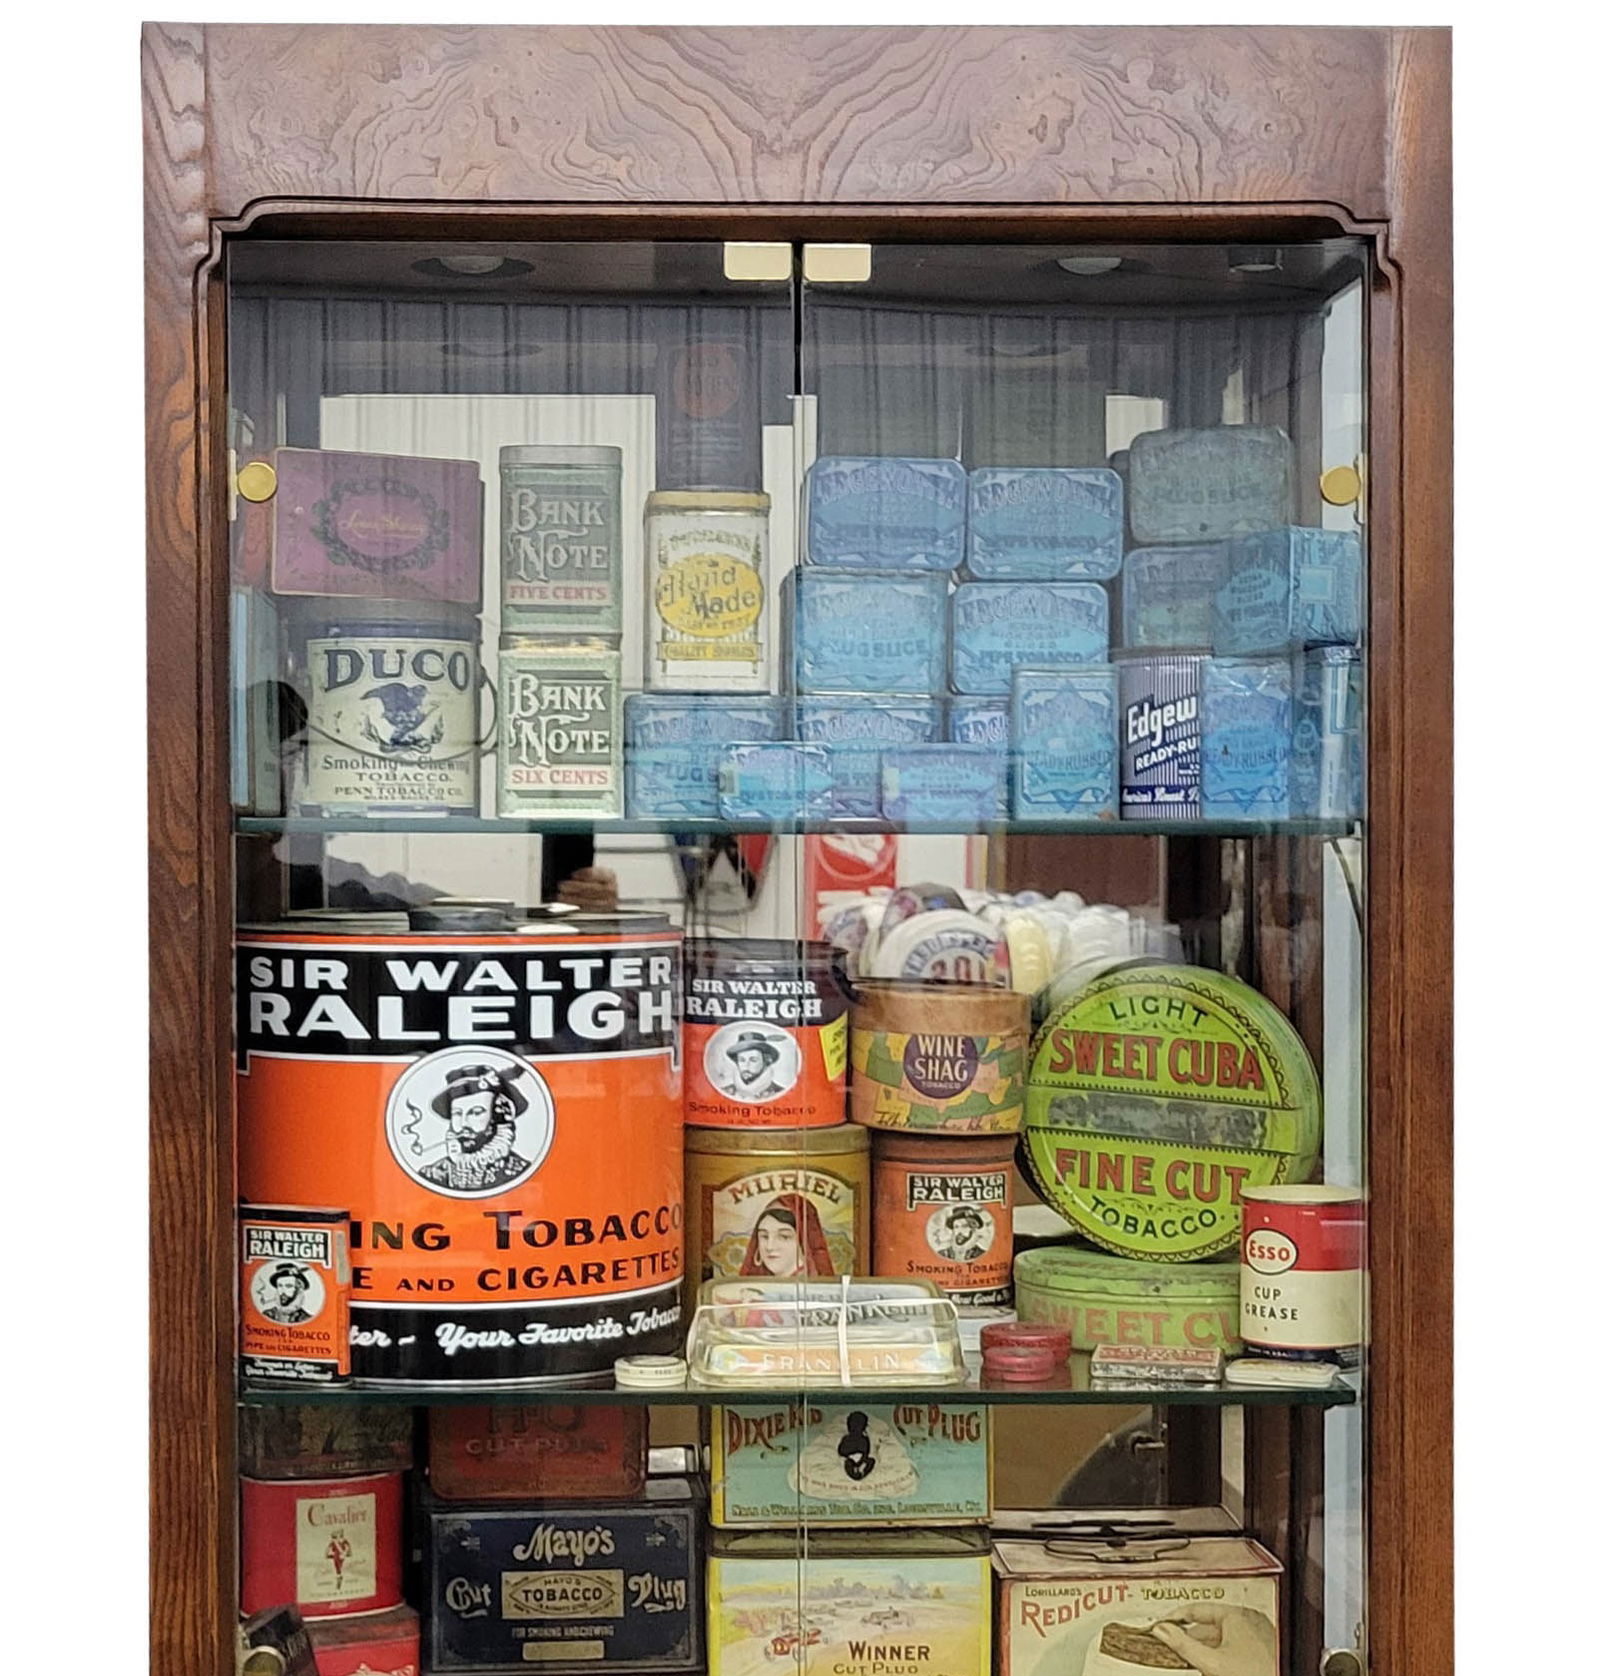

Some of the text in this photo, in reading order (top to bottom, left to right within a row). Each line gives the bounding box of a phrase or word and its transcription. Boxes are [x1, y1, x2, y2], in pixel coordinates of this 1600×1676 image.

[510, 489, 605, 533] BANK
[509, 527, 608, 582] NOTE
[510, 586, 608, 599] FIVE CENTS
[324, 649, 470, 692] DUCO
[511, 672, 606, 717] BANK
[1127, 696, 1197, 748] Edgew
[509, 712, 610, 768] NOTE
[322, 755, 398, 772] Smoking
[512, 770, 608, 784] SIX CENTS
[335, 787, 373, 795] PENN
[250, 956, 672, 991] SIR WALTER
[693, 979, 816, 995] SIR WALTER
[249, 991, 673, 1040] RALEIGH
[687, 997, 822, 1019] RALEIGH
[1108, 995, 1208, 1028] LIGHT
[918, 1034, 966, 1057] WINE
[914, 1056, 968, 1081] SHAG
[1049, 1029, 1265, 1091] SWEET CUBA
[689, 1102, 751, 1117] Smoking
[914, 1176, 1003, 1188] SIR WALTER
[1053, 1147, 1251, 1205] FINE CUT
[727, 1173, 843, 1205] MURIEL
[913, 1187, 1003, 1200] RALEIGH
[484, 1206, 682, 1251] TOBACCO
[1091, 1195, 1217, 1239] TOBACCO
[251, 1230, 324, 1242] SIR WALTER
[250, 1241, 325, 1258] RALEIGH
[397, 1248, 680, 1291] AND CIGARETTES
[907, 1260, 963, 1273] SMOKING
[1254, 1286, 1281, 1301] CUP
[1245, 1302, 1299, 1321] GREASE
[246, 1325, 330, 1341] SMOKING TOBACCO
[436, 1314, 624, 1356] Your Favorite
[726, 1408, 788, 1456] DIXIE
[928, 1403, 982, 1443] PLUG
[307, 1503, 368, 1528] Cavalier
[513, 1523, 616, 1567] Mayo's
[446, 1576, 494, 1612] Cut
[522, 1587, 602, 1602] TOBACCO
[627, 1573, 687, 1613] Plug
[1141, 1587, 1225, 1601] TOBACCO
[1020, 1583, 1129, 1638] REDICUT
[848, 1641, 931, 1662] WINNER
[833, 1664, 868, 1676] CUT
